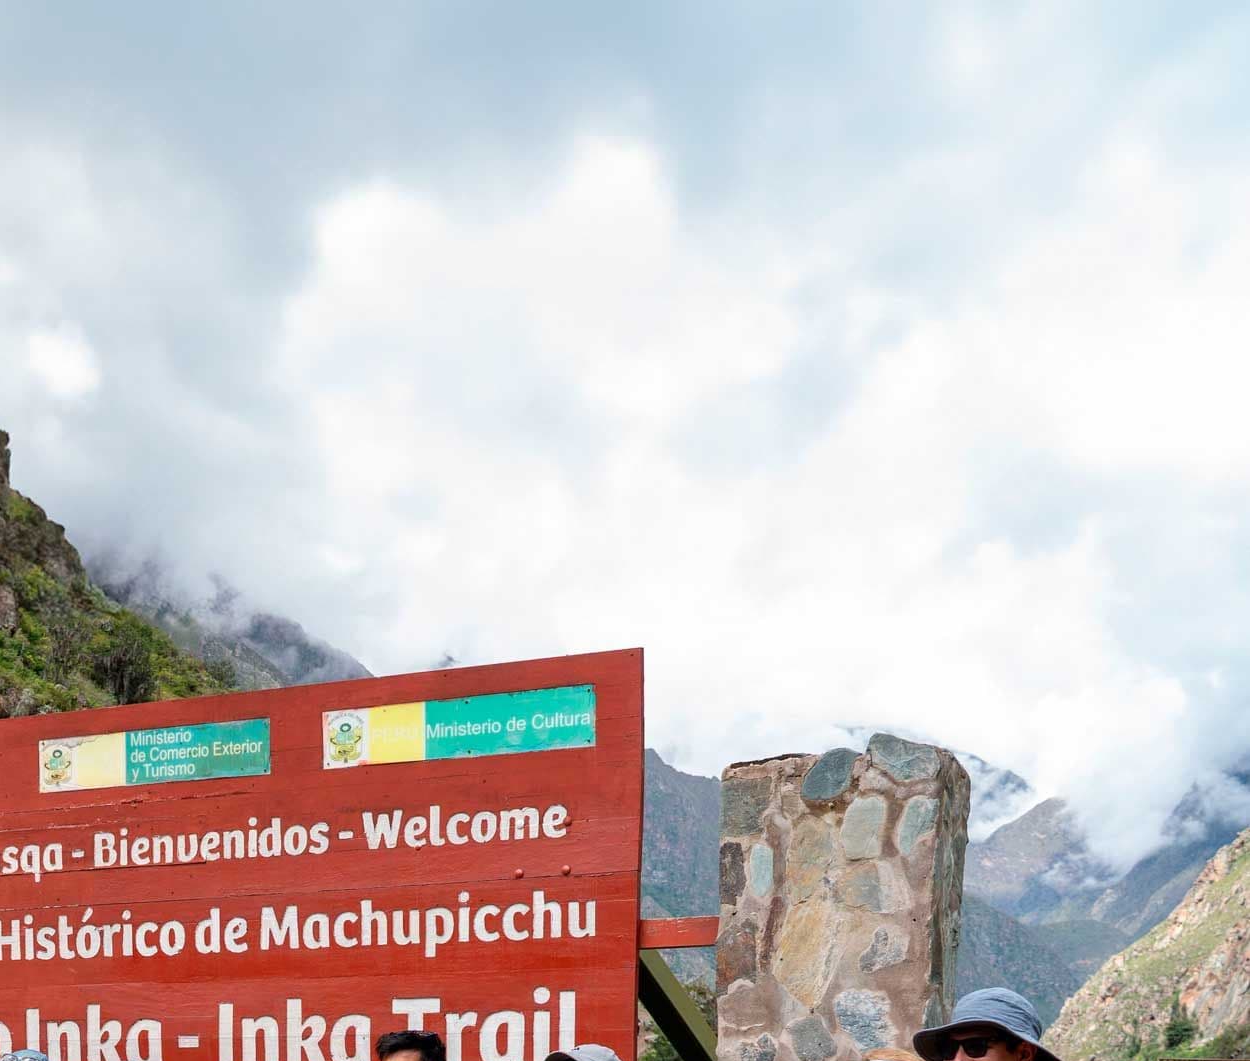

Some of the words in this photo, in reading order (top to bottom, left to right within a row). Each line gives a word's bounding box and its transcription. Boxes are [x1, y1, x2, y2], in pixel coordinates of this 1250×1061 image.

[130, 729, 192, 746] Ministerio
[426, 718, 502, 739] Ministerio
[506, 715, 527, 732] de
[531, 709, 591, 729] Cultura
[131, 749, 146, 763] de
[149, 744, 209, 761] Comercio
[213, 739, 263, 756] Exterior
[132, 767, 140, 782] y
[144, 762, 196, 778] Turismo
[93, 816, 330, 867] Bienvenidos
[362, 804, 568, 850] Welcome
[195, 907, 248, 954] de
[260, 890, 597, 958] Machupicchu
